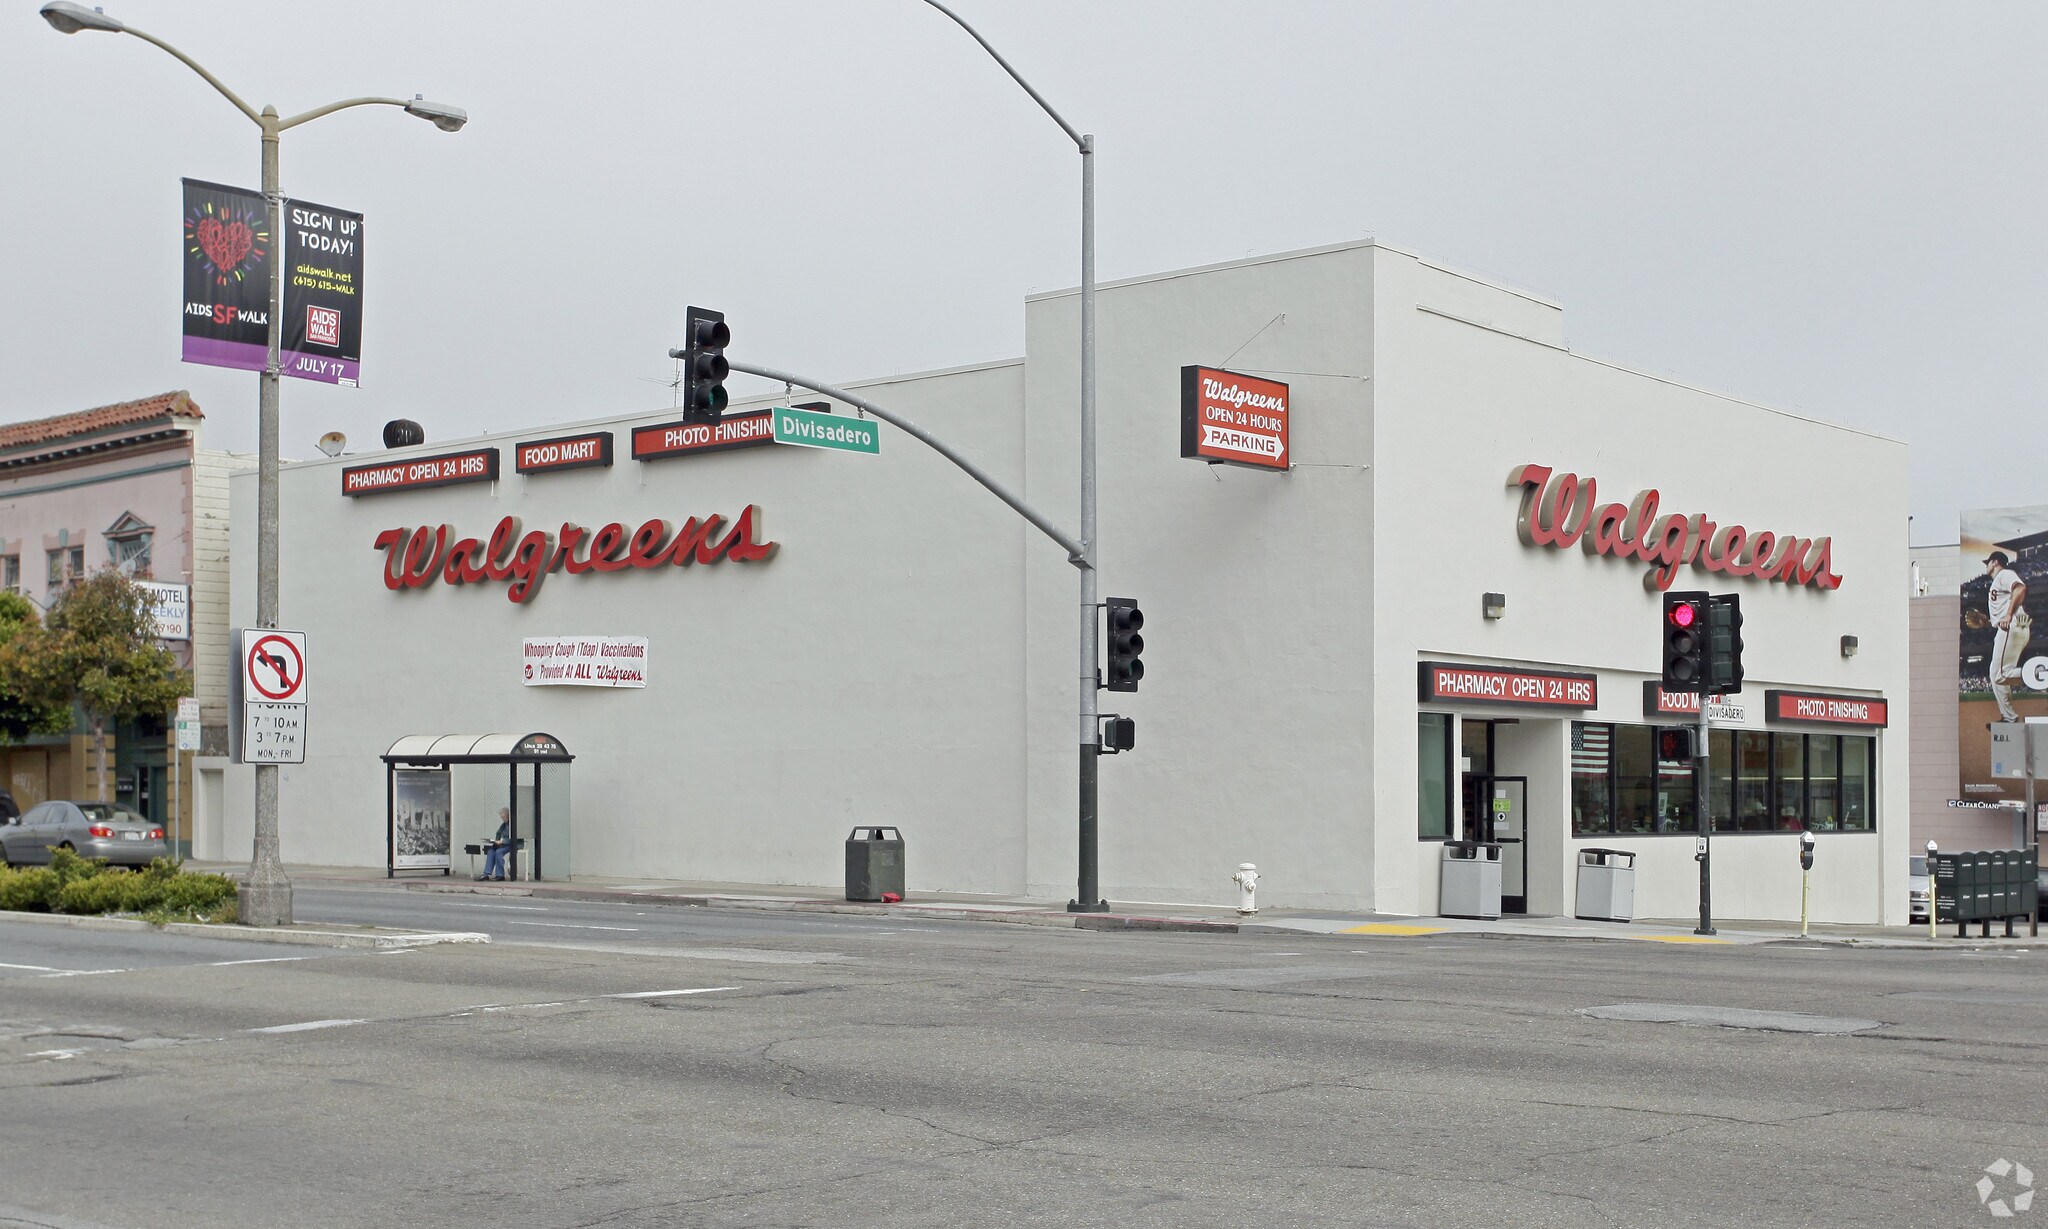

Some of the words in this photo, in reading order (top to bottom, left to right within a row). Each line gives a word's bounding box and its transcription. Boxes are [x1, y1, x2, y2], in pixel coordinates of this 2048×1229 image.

[292, 208, 333, 231] SIGN
[340, 219, 357, 236] UP
[298, 230, 354, 257] TODAY!
[297, 264, 352, 282] aidswalk.net
[293, 275, 317, 289] (415)
[318, 280, 355, 295] 615-WALK
[185, 302, 213, 317] AIDS
[213, 303, 237, 325] SF
[238, 310, 268, 325] WALK
[310, 310, 337, 326] AIDS
[310, 323, 336, 337] WALK
[296, 357, 328, 374] JULY
[330, 363, 345, 377] 17
[1203, 378, 1285, 412] Walgreens
[1206, 405, 1234, 423] OPEN
[1236, 411, 1247, 426] 24
[1250, 413, 1282, 432] HOURS
[665, 427, 710, 447] PHOTO
[715, 418, 773, 441] FINISHIN
[782, 416, 871, 446] Divisadero
[1211, 430, 1275, 453] PARKING
[525, 446, 559, 466] FOOD
[561, 441, 596, 460] MART
[349, 467, 405, 489] PHARMACY
[409, 464, 440, 481] OPEN
[443, 461, 457, 476] 24
[460, 457, 484, 474] HRS
[1512, 464, 1843, 591] Walgreens
[373, 504, 775, 603] Walgreens
[152, 607, 186, 618] EEKLY
[524, 642, 554, 658] Whooping
[555, 642, 575, 658] Cough
[577, 642, 599, 658] (Tdap)
[600, 643, 644, 658] Vaccinations
[540, 664, 564, 679] Provided
[565, 664, 574, 678] At
[574, 663, 591, 679] ALL
[596, 664, 643, 685] Walgreens
[1439, 672, 1507, 696] PHARMACY
[1512, 677, 1545, 698] OPEN
[1549, 680, 1563, 699] 24
[1567, 682, 1590, 702] HRS
[1661, 691, 1689, 709] FOOD
[1797, 699, 1825, 716] PHOTO
[1828, 701, 1868, 719] FINISHING
[253, 716, 260, 727] 7
[274, 717, 285, 728] 10
[1709, 706, 1743, 719] DIVISADERO
[256, 731, 263, 743] 3
[274, 732, 281, 743] 7
